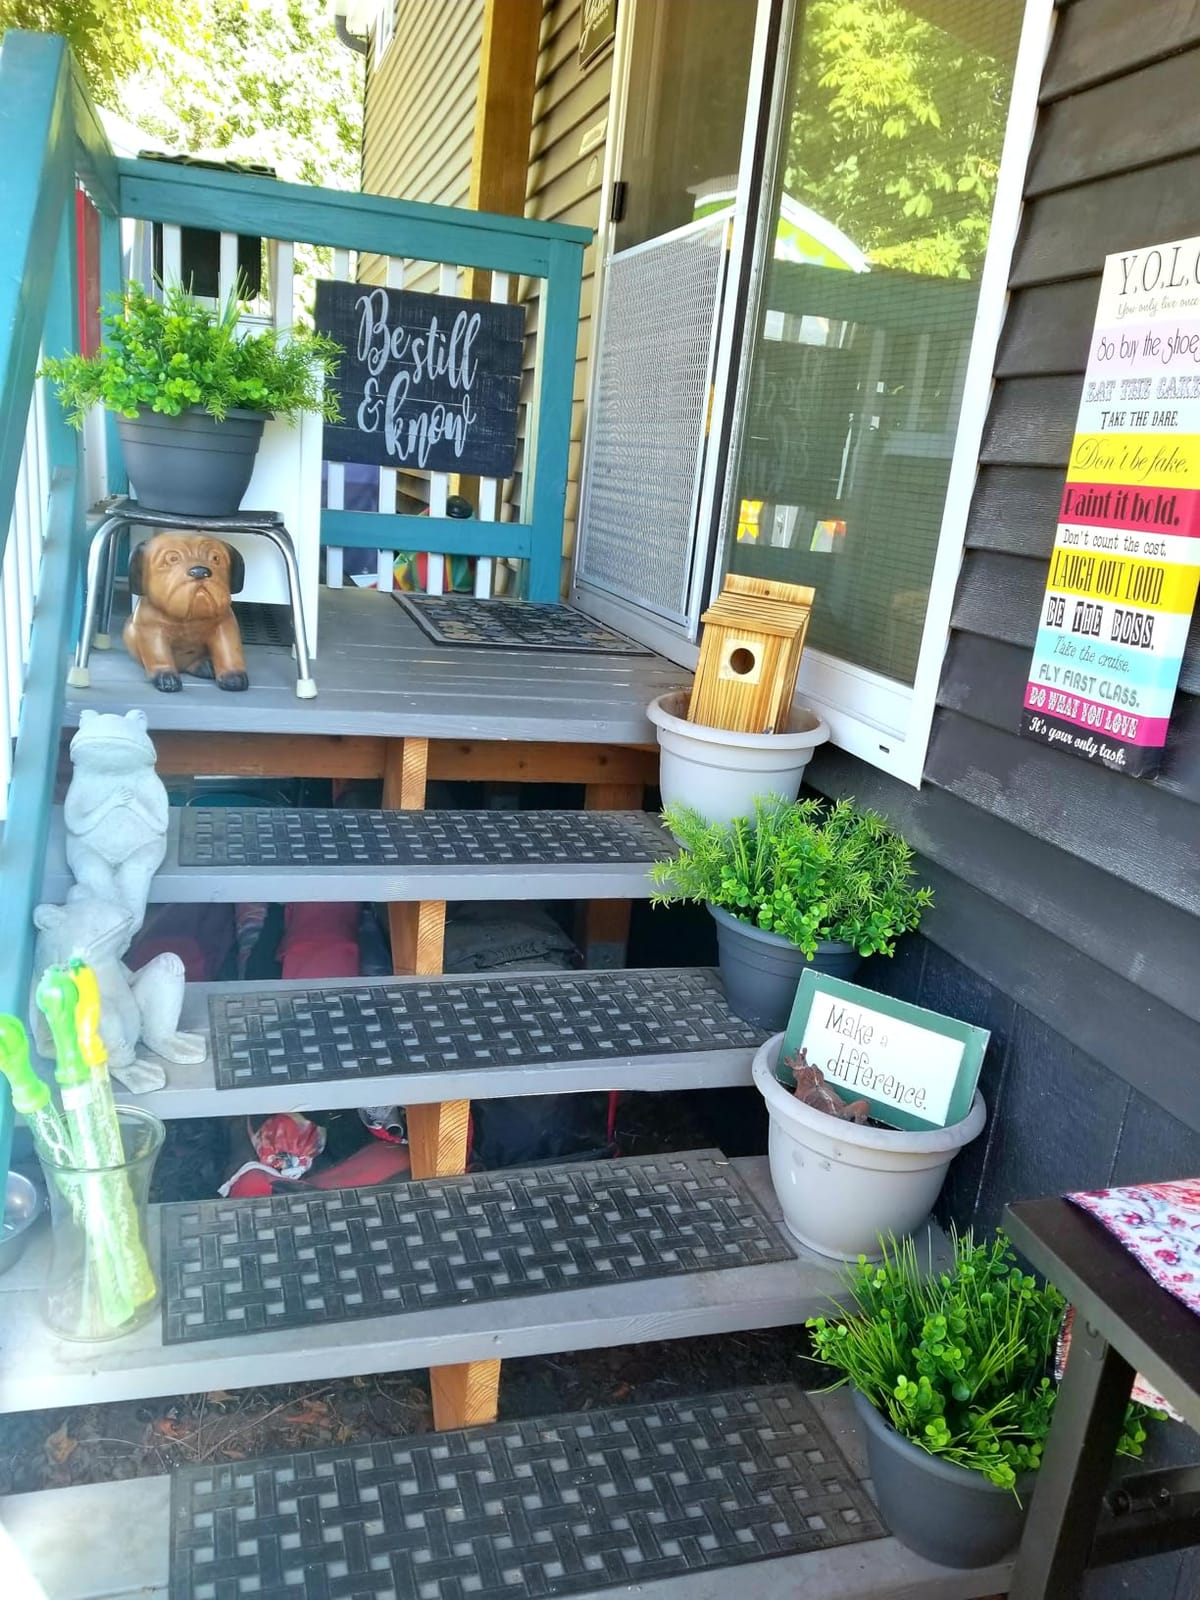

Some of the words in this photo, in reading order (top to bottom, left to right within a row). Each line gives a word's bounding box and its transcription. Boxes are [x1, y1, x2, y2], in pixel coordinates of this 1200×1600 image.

[1118, 246, 1200, 296] Y.O.L.
[1115, 302, 1135, 320] You
[1138, 297, 1157, 317] only
[1161, 295, 1177, 309] live
[354, 288, 411, 376] Be
[411, 310, 481, 390] still
[1097, 336, 1115, 362] So
[1119, 333, 1140, 366] buy
[1142, 329, 1161, 357] the
[1085, 380, 1117, 403] EAT
[1119, 377, 1152, 401] THE
[357, 377, 384, 433] &
[384, 370, 477, 468] know
[1129, 411, 1150, 427] THE
[1151, 410, 1179, 427] DARE.
[1072, 437, 1129, 471] Don't
[1129, 446, 1149, 471] be
[1137, 445, 1189, 482] fake.
[1063, 488, 1113, 519] Paint
[1113, 489, 1129, 521] it
[1130, 492, 1180, 526] bold.
[1063, 528, 1089, 546] Don't
[1092, 533, 1119, 551] count
[1123, 535, 1140, 553] the
[1143, 539, 1167, 557] cost.
[1051, 550, 1096, 593] LAUGH
[1096, 559, 1126, 598] OUT
[1125, 563, 1165, 606] LOUD.
[1046, 596, 1066, 628] BE
[1071, 601, 1104, 637] THE
[1110, 608, 1155, 650] BOSS.
[1053, 635, 1078, 658] Take
[1079, 645, 1096, 664] the
[1098, 653, 1131, 673] cruise.
[1038, 663, 1061, 683] FLY
[1062, 670, 1097, 694] FIRST
[1098, 680, 1140, 708] CLASS.
[1028, 686, 1047, 707] DO
[1047, 690, 1081, 719] WHAT
[1080, 702, 1106, 728] YOU
[1103, 709, 1140, 740] LOVE
[1028, 716, 1047, 735] It's
[1047, 726, 1074, 742] your
[1073, 736, 1099, 758] only
[1098, 743, 1127, 766] task.
[825, 1004, 874, 1045] Make
[879, 1034, 889, 1049] a
[826, 1042, 927, 1111] difference.
